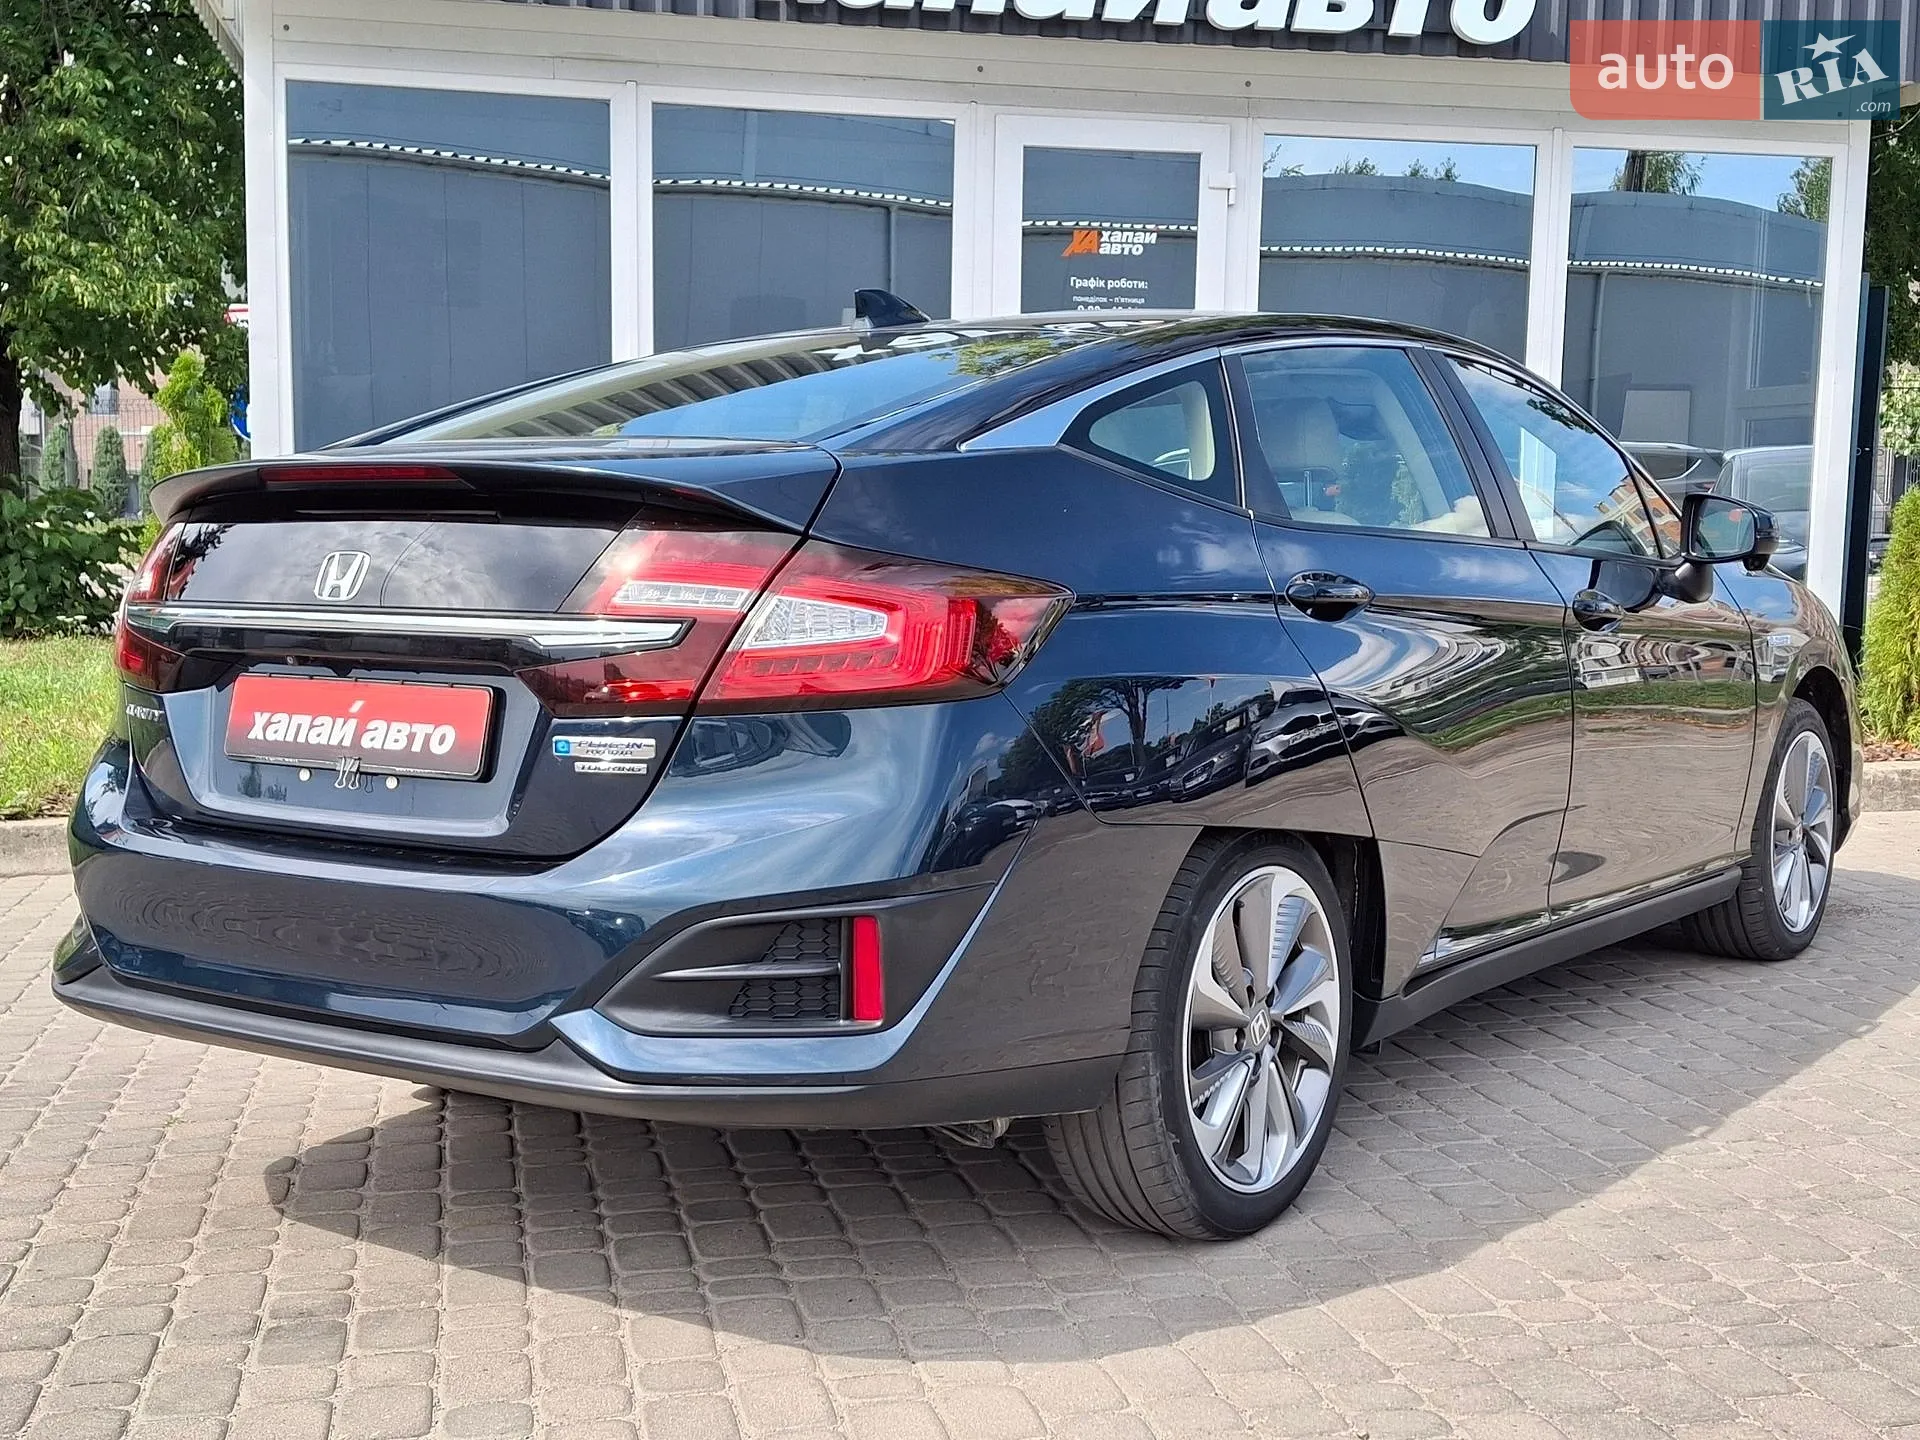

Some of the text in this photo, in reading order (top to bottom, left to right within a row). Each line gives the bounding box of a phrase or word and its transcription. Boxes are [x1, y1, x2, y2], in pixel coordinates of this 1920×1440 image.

[1098, 243, 1144, 256] авто
[1069, 276, 1148, 290] Графік роботи:
[247, 699, 456, 756] хапай авто
